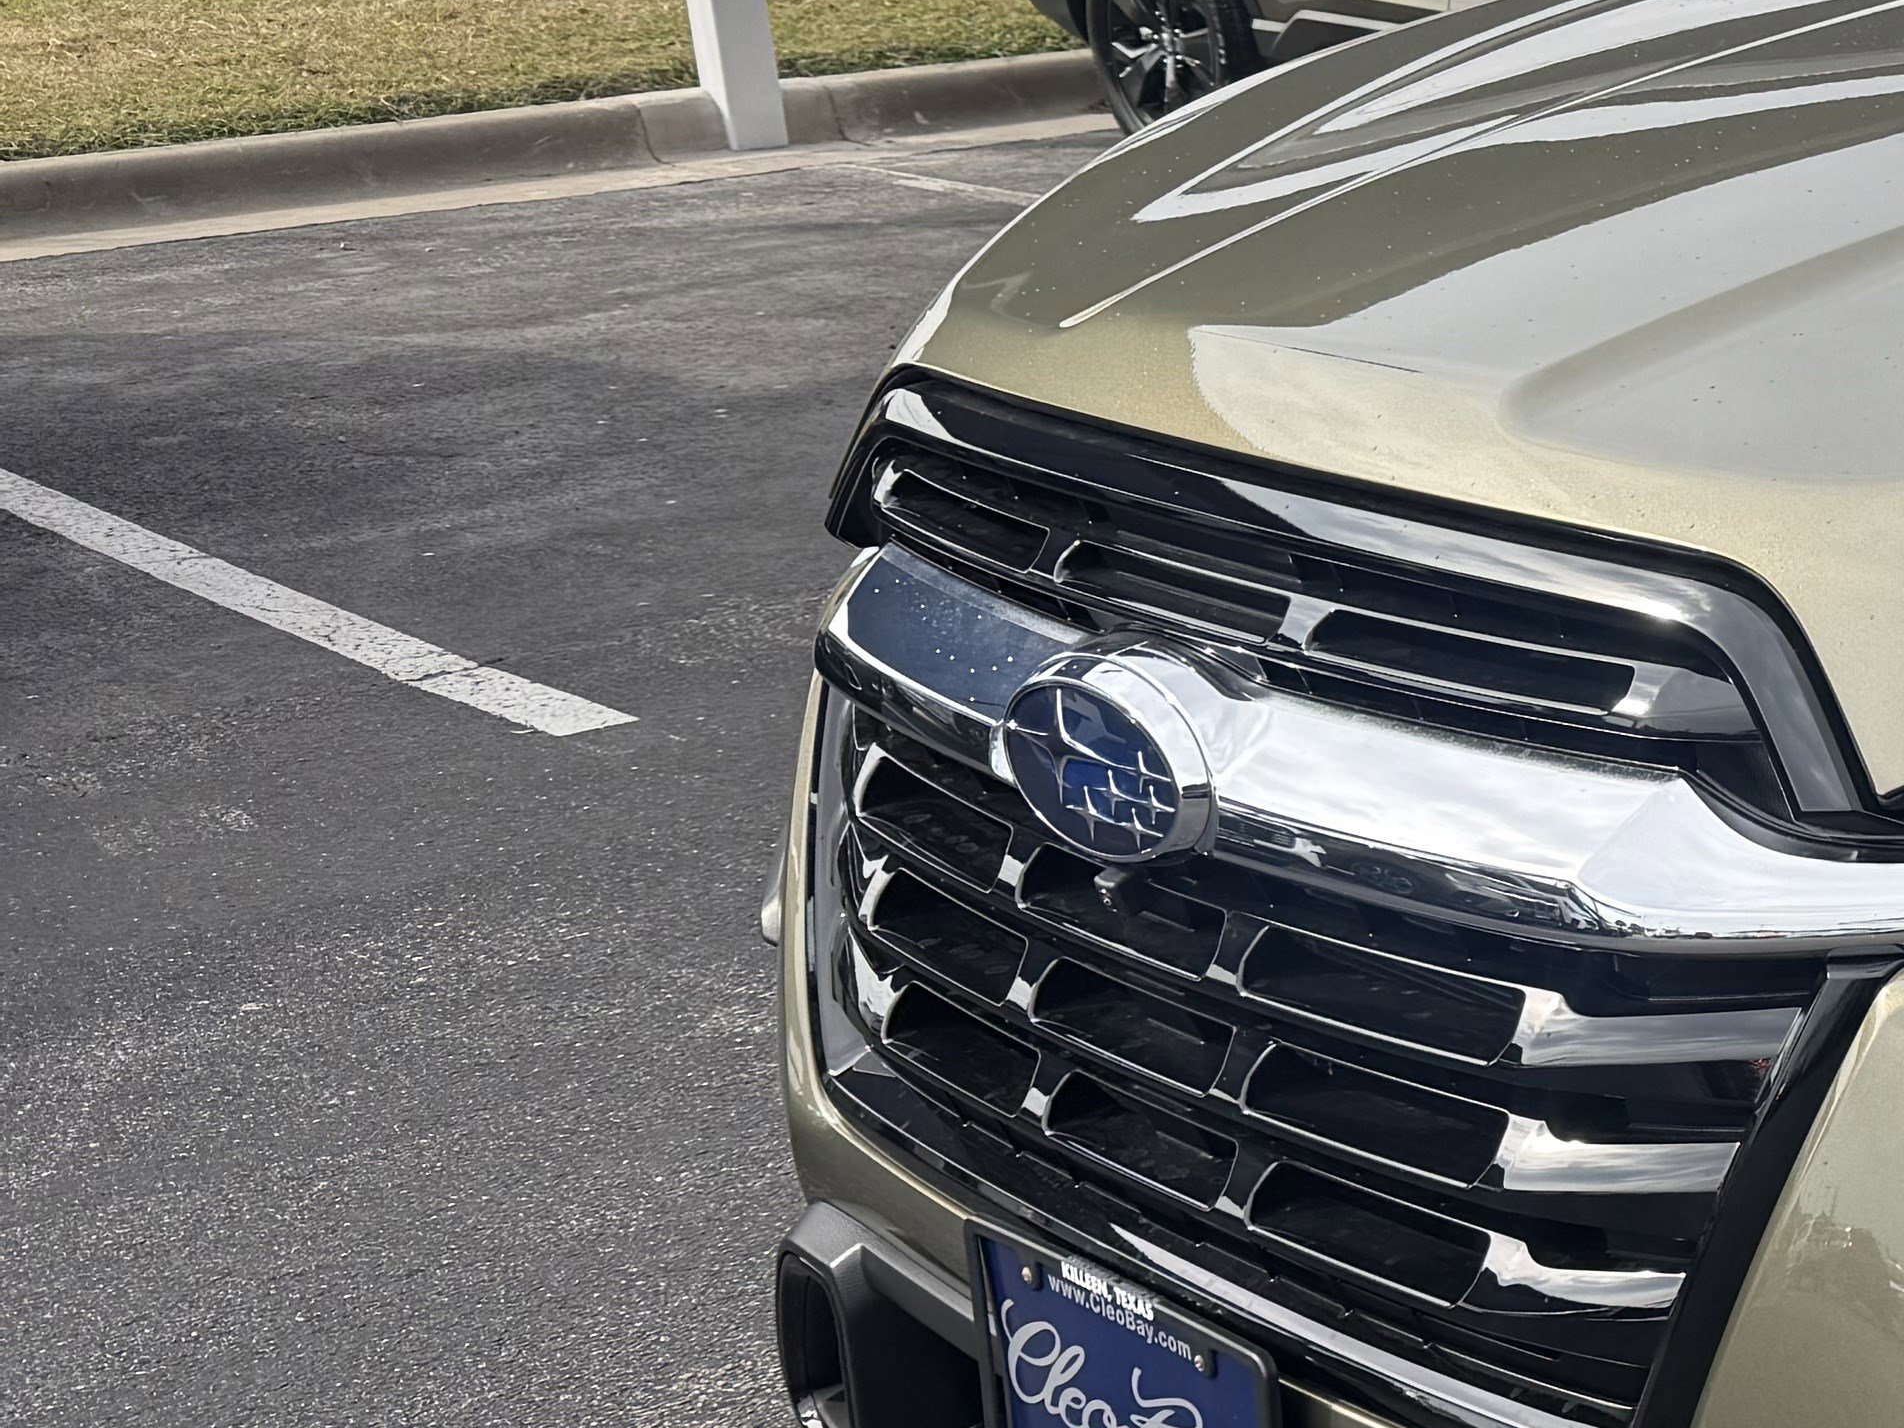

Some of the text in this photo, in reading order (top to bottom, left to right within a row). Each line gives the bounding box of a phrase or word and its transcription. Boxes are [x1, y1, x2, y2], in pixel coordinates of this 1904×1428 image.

[1048, 1274, 1192, 1361] www.CleoBay.com
[1061, 1261, 1155, 1321] KILLEEN, TEXAS
